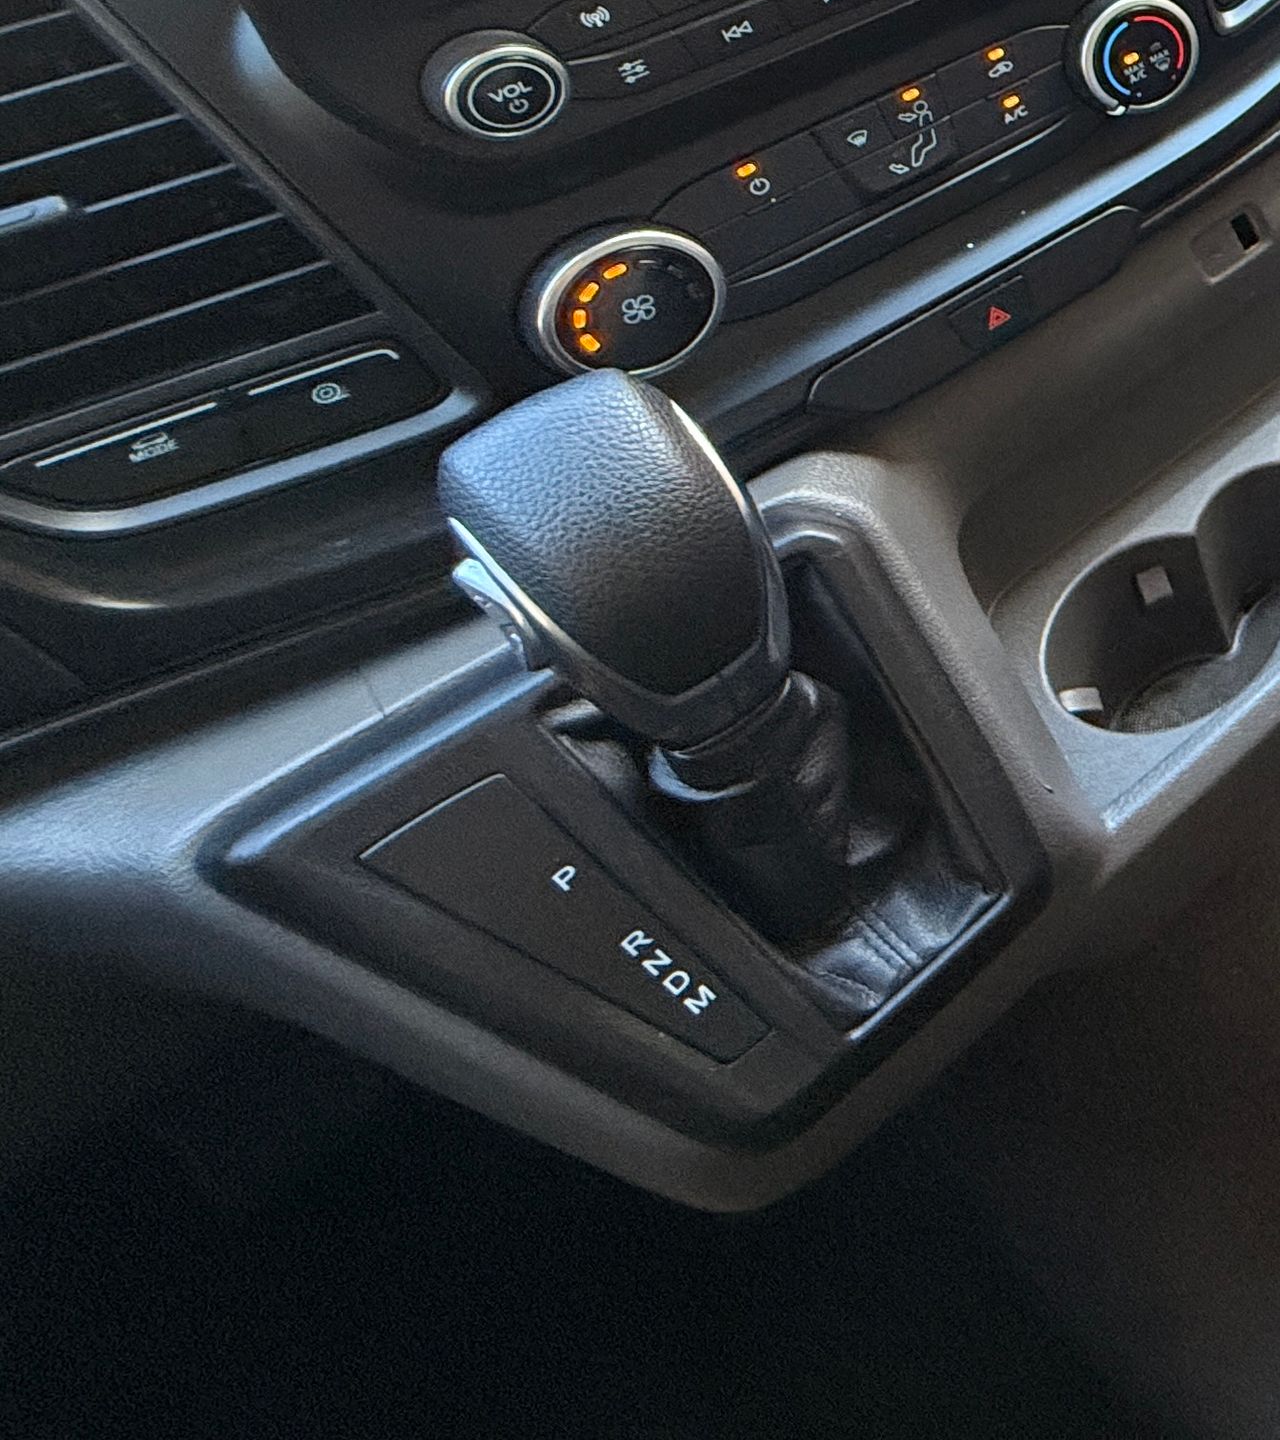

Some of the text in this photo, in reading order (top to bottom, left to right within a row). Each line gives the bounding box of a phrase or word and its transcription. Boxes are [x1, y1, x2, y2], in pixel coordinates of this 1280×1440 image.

[487, 81, 533, 103] VOL
[1004, 105, 1029, 125] A/C
[551, 865, 577, 892] P
[620, 930, 654, 957] R
[662, 970, 691, 996] D
[683, 984, 717, 1015] M
